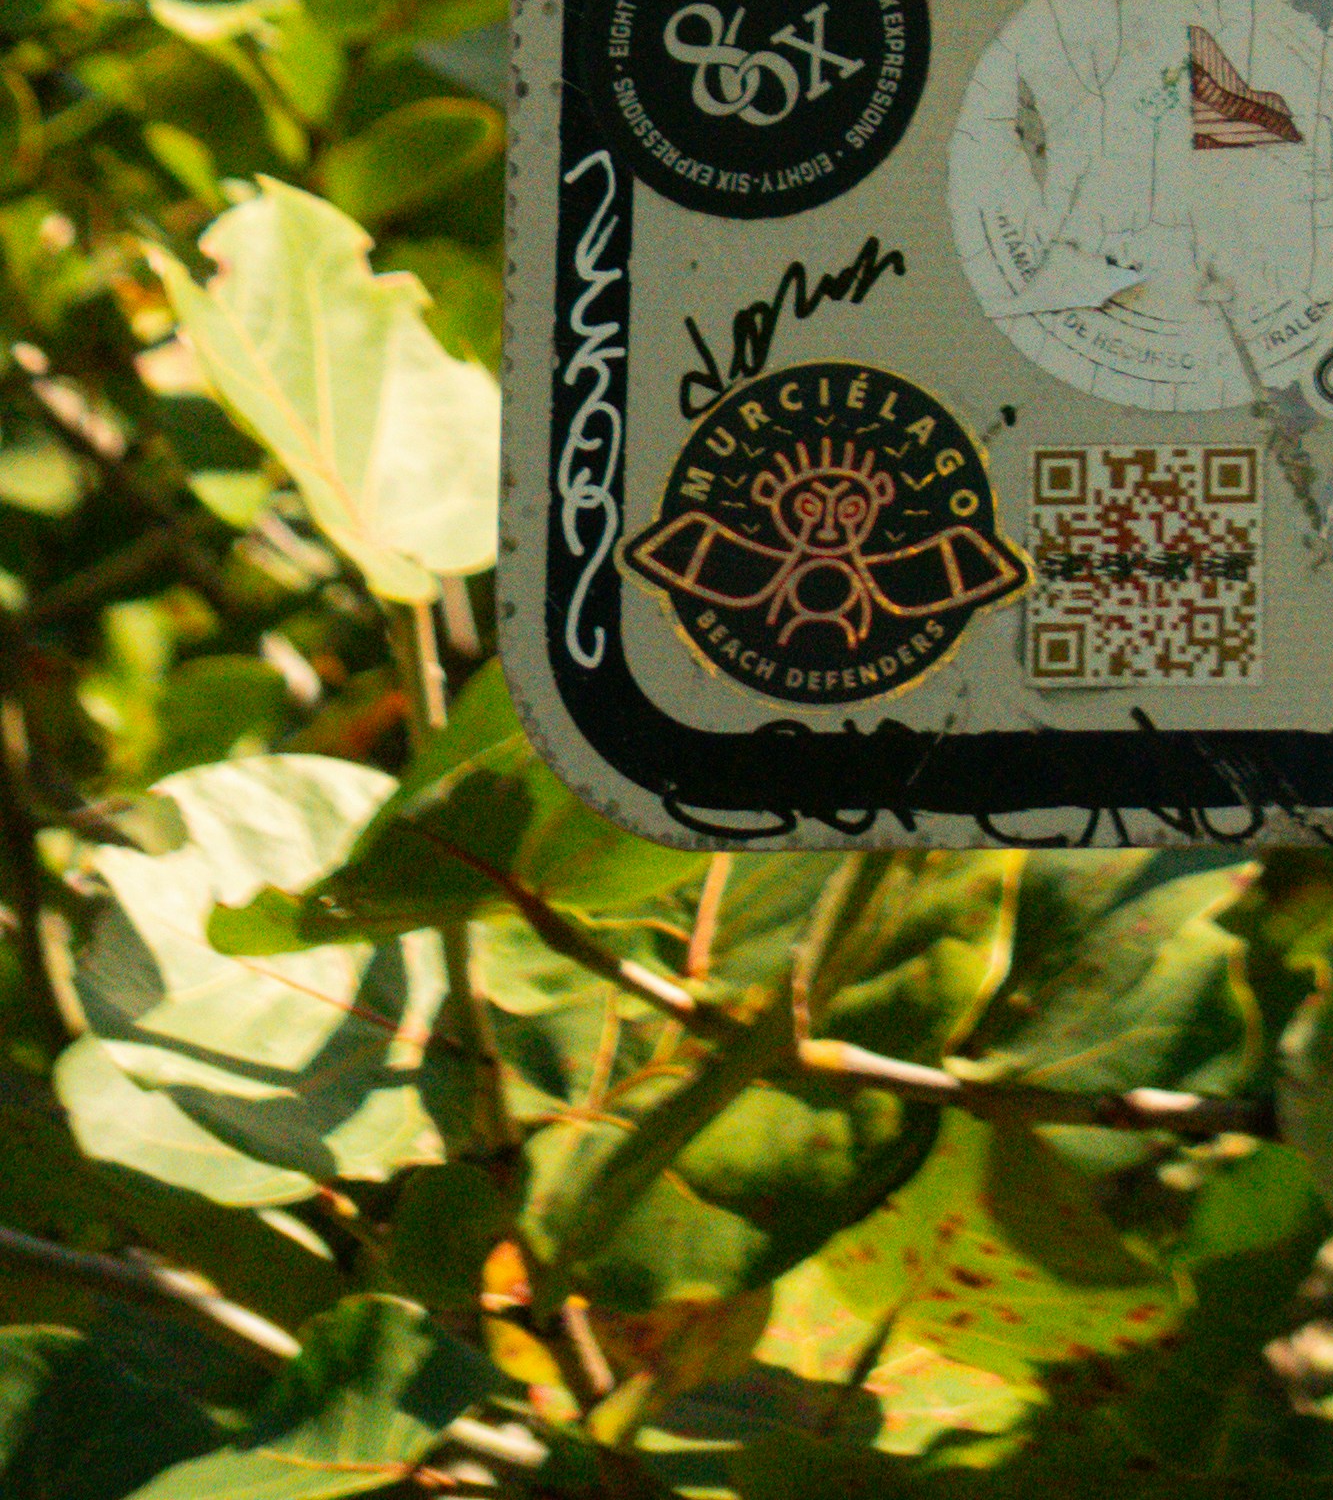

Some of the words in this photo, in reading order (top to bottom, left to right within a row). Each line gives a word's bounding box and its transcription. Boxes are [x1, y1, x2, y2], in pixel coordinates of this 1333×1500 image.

[612, 76, 716, 187] EXPRESSIONS
[844, 11, 906, 150] EXPRESSIONS
[679, 372, 980, 517] MURCIÉLAGO
[696, 609, 776, 680] BEACH
[786, 619, 946, 691] DEFENDERS
